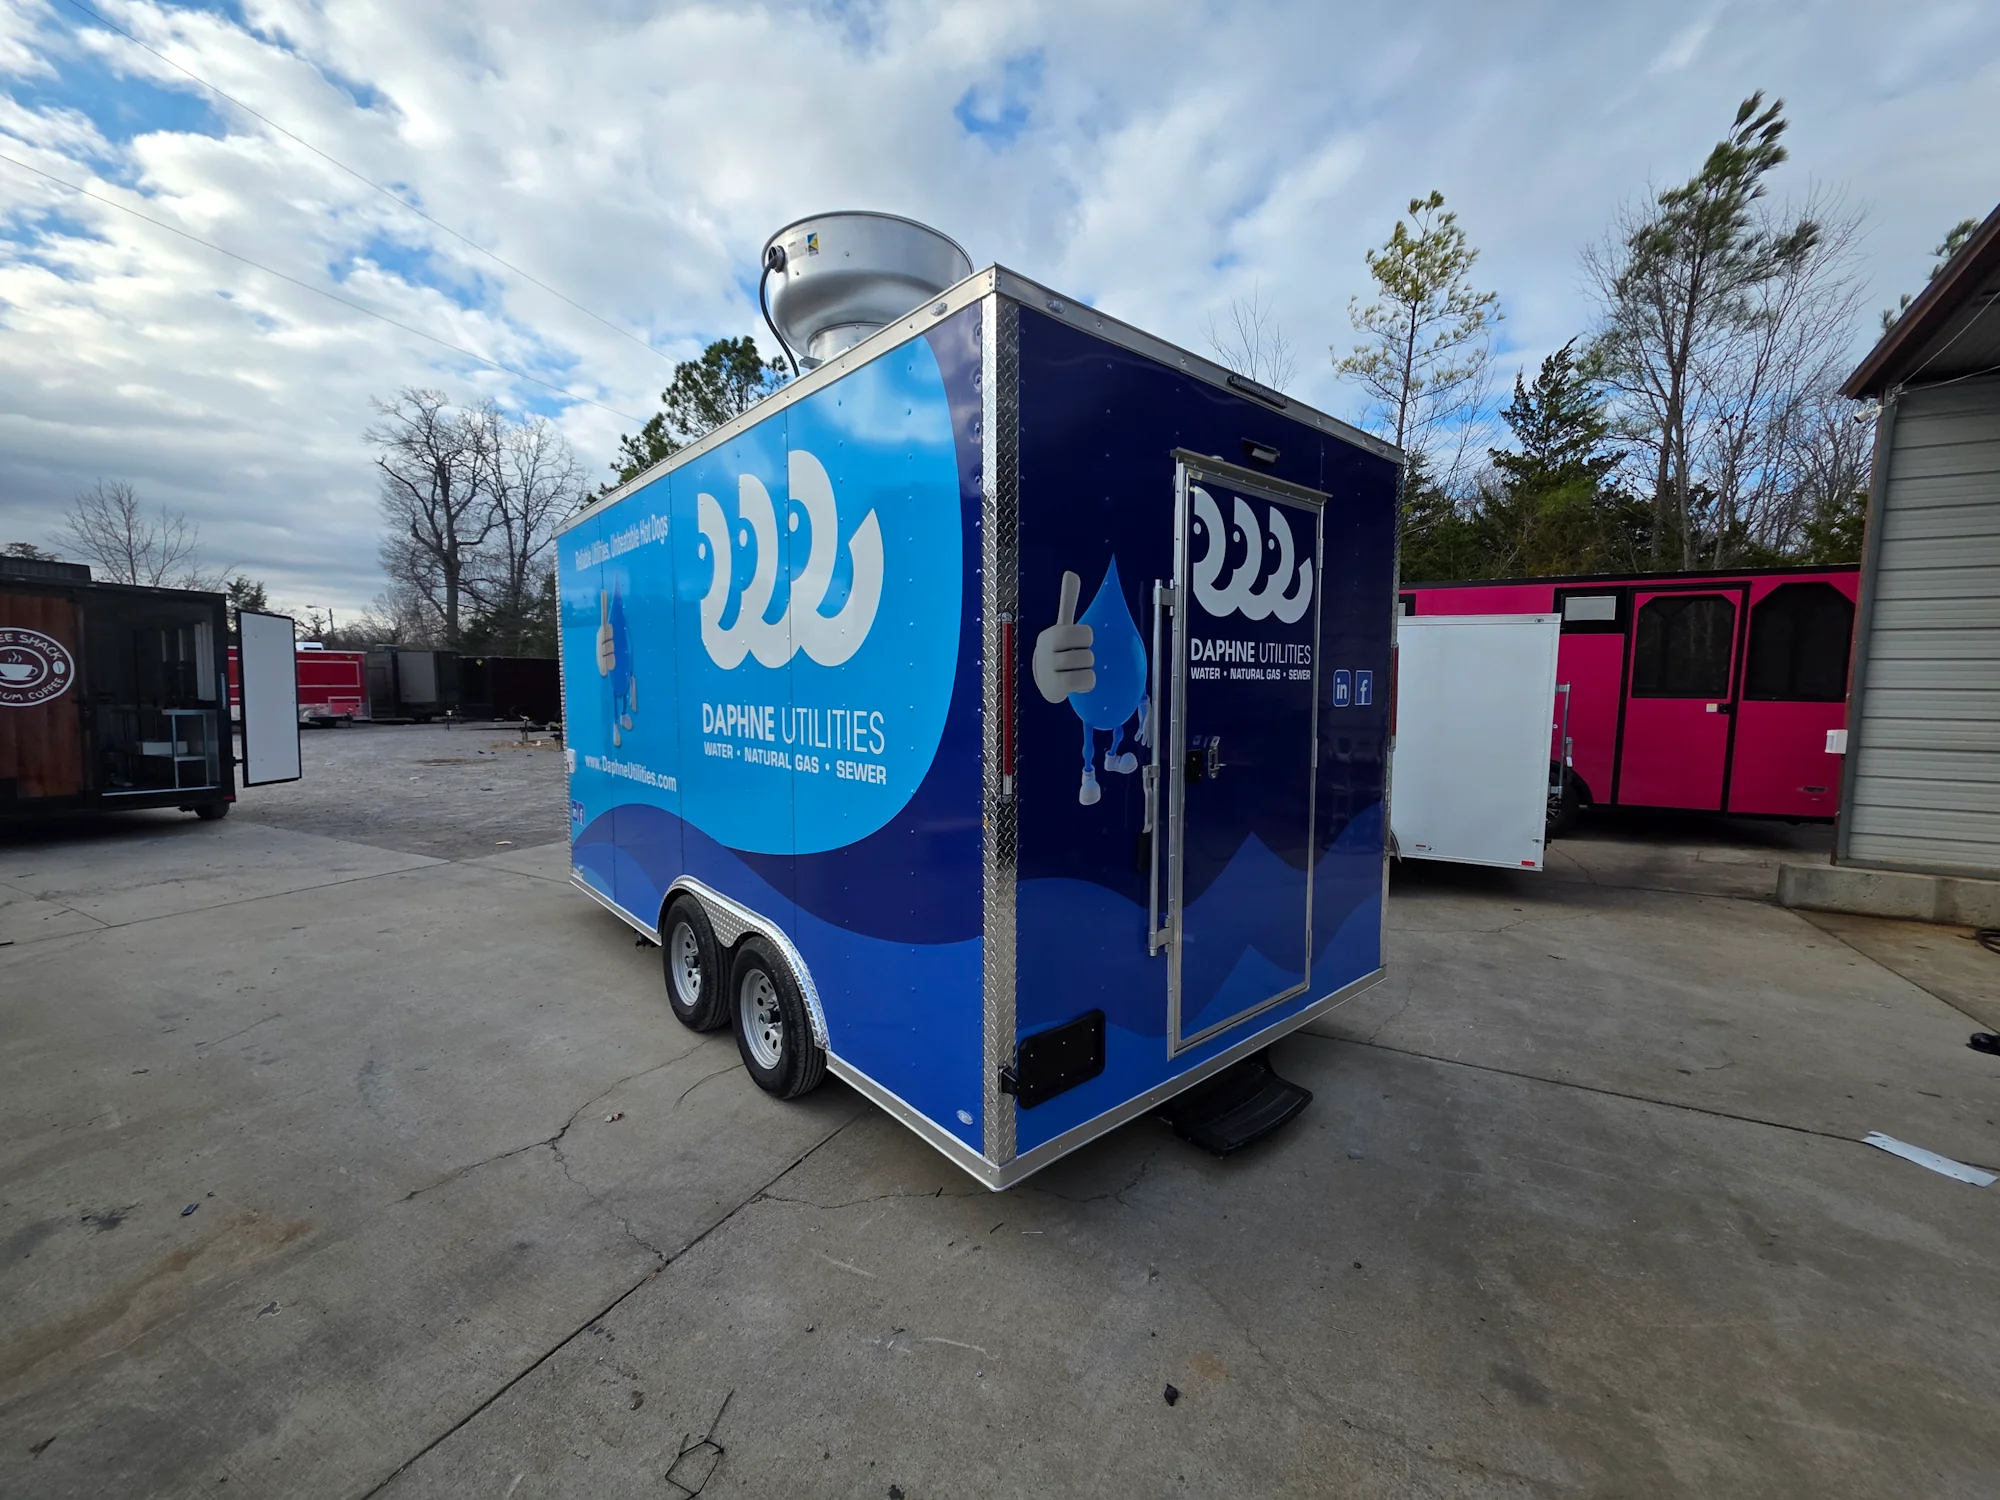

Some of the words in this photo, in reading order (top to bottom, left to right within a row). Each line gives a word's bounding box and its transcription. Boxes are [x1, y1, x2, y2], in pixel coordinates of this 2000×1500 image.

[639, 517, 652, 546] Hot
[651, 513, 669, 545] Dogs
[19, 634, 63, 660] SHACK
[1190, 637, 1256, 663] DAPHNE
[1259, 642, 1312, 665] UTILITIES
[28, 677, 64, 699] COFFEE
[1190, 667, 1221, 680] WATER
[1230, 667, 1265, 680] NATURAL
[1266, 668, 1281, 680] GAS
[1288, 669, 1311, 681] SEWER
[702, 702, 775, 742] DAPHNE
[781, 706, 885, 755] UTILITIES
[703, 741, 734, 759] WATER
[744, 746, 792, 771] NATURAL
[795, 753, 819, 774] GAS
[836, 759, 887, 786] SEWER
